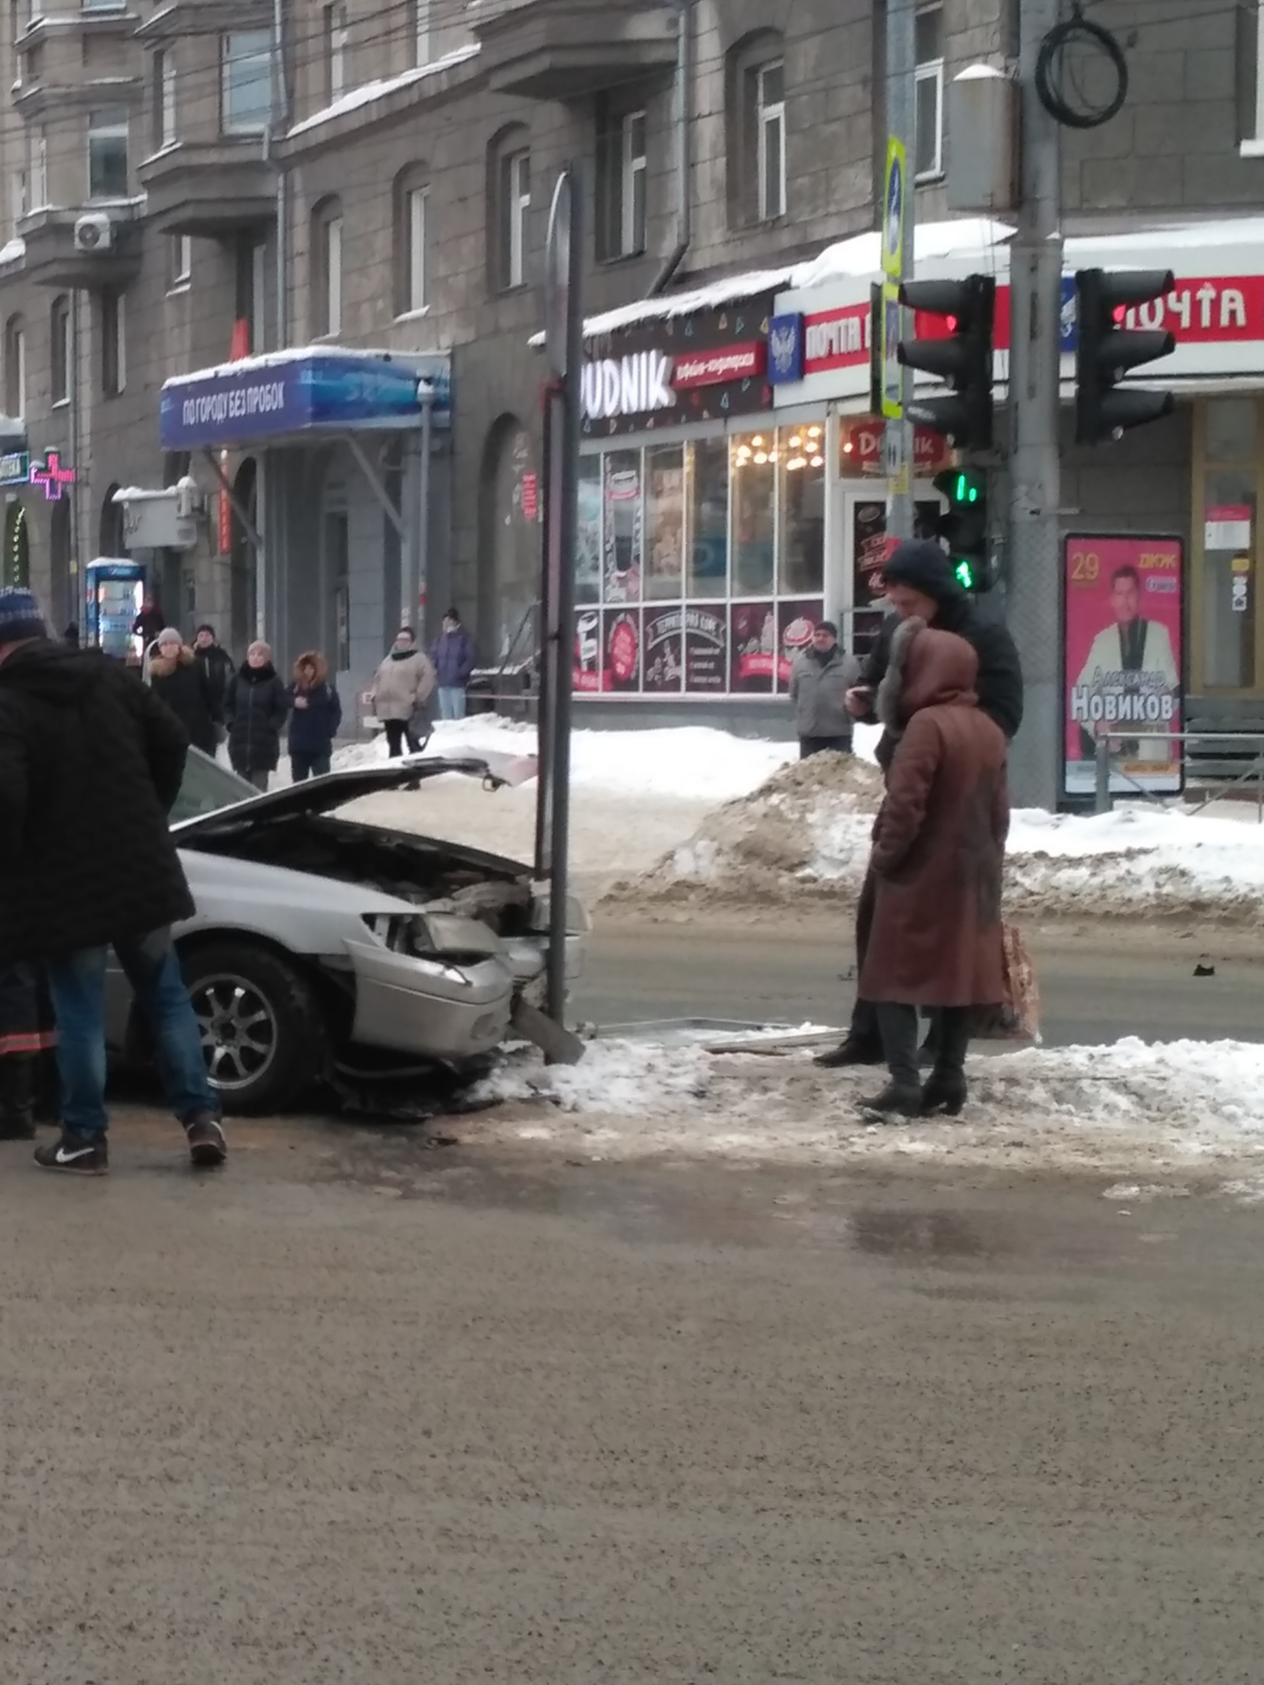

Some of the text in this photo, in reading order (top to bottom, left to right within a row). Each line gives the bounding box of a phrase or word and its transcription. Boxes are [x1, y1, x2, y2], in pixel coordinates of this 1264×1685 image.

[806, 316, 862, 360] ПОЧТА
[182, 381, 285, 425] ПО ГОРОДУ БЕЗ ПРОБОК
[581, 350, 672, 418] UDNIK
[1072, 551, 1098, 580] 29
